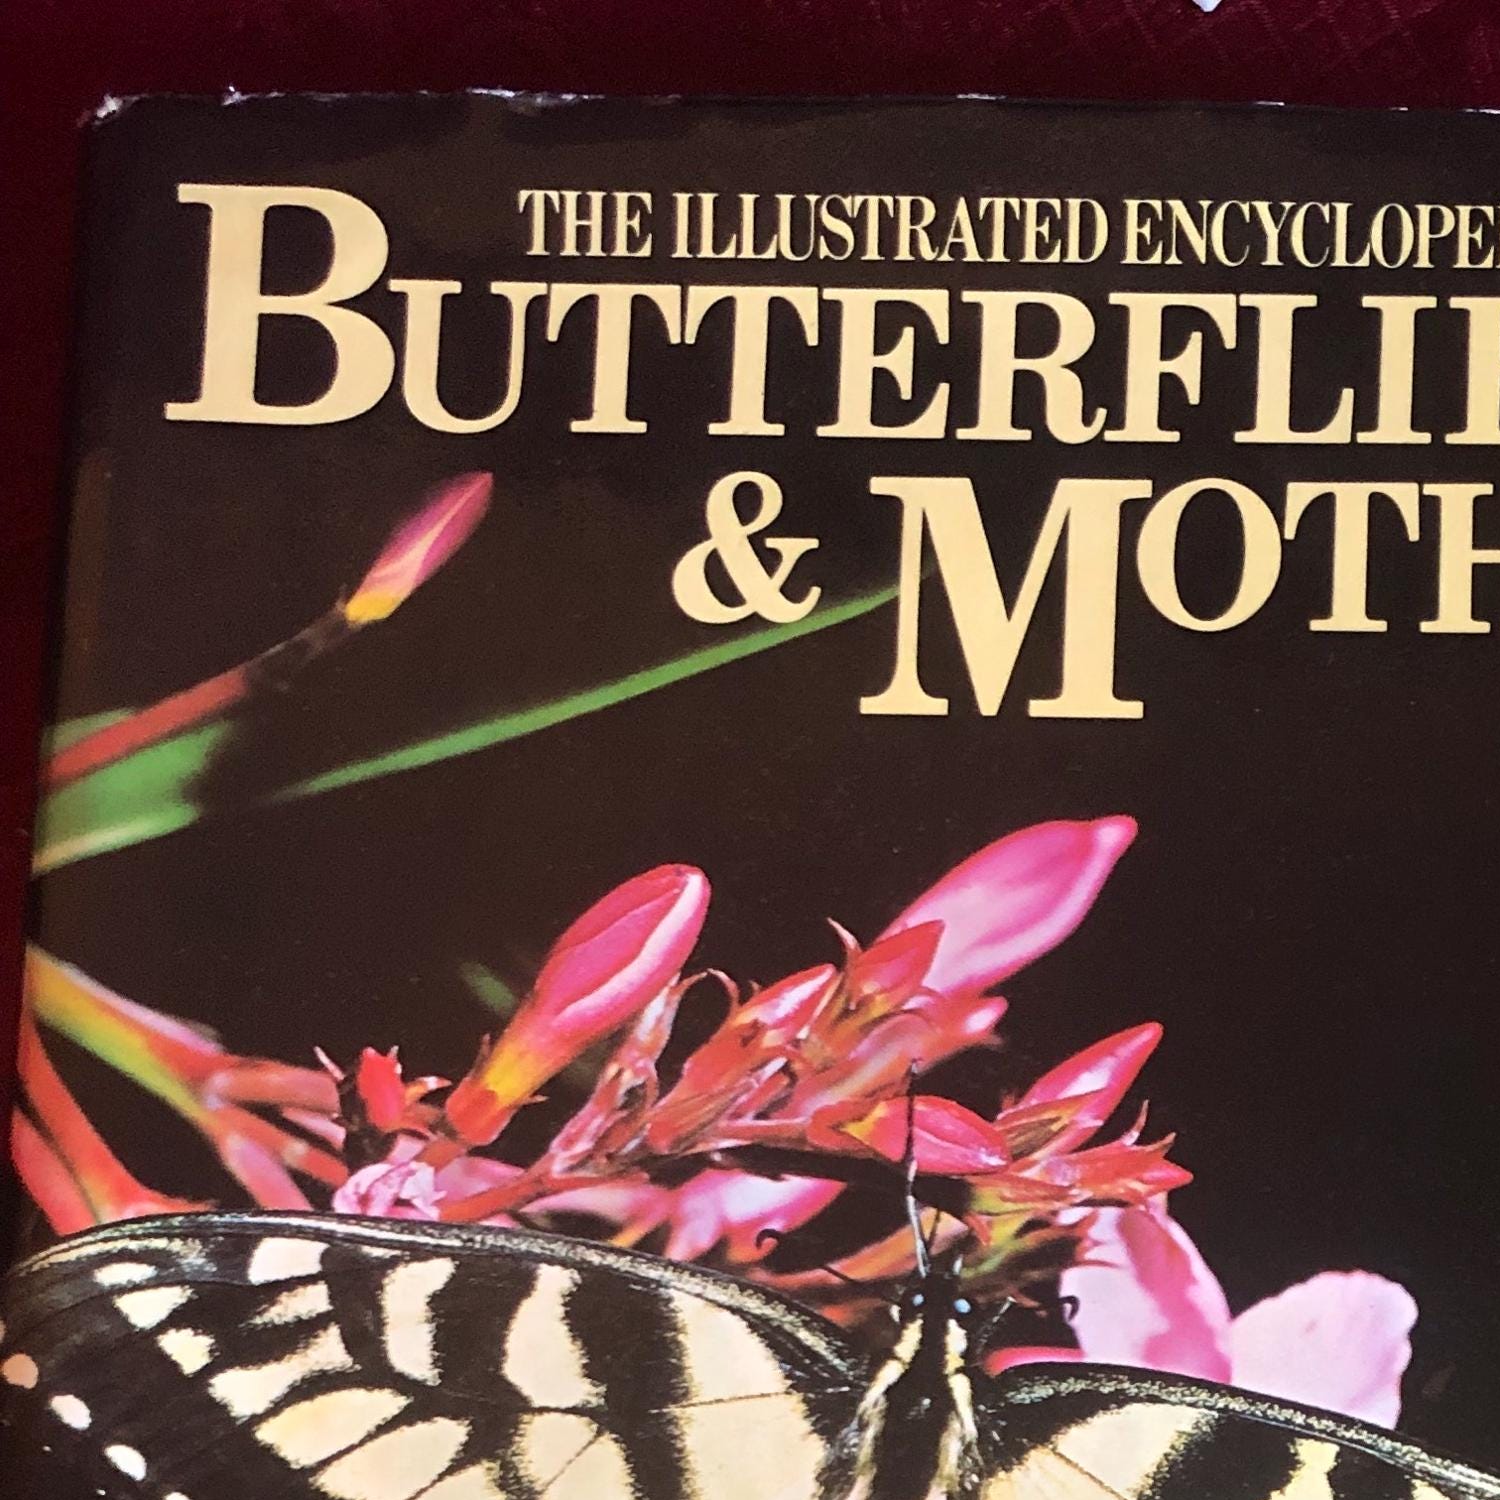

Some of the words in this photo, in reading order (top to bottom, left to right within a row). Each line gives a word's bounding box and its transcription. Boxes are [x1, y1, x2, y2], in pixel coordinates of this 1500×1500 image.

[518, 189, 653, 257] THE
[671, 192, 1110, 263] ILLUSTRATED
[670, 469, 822, 626] &
